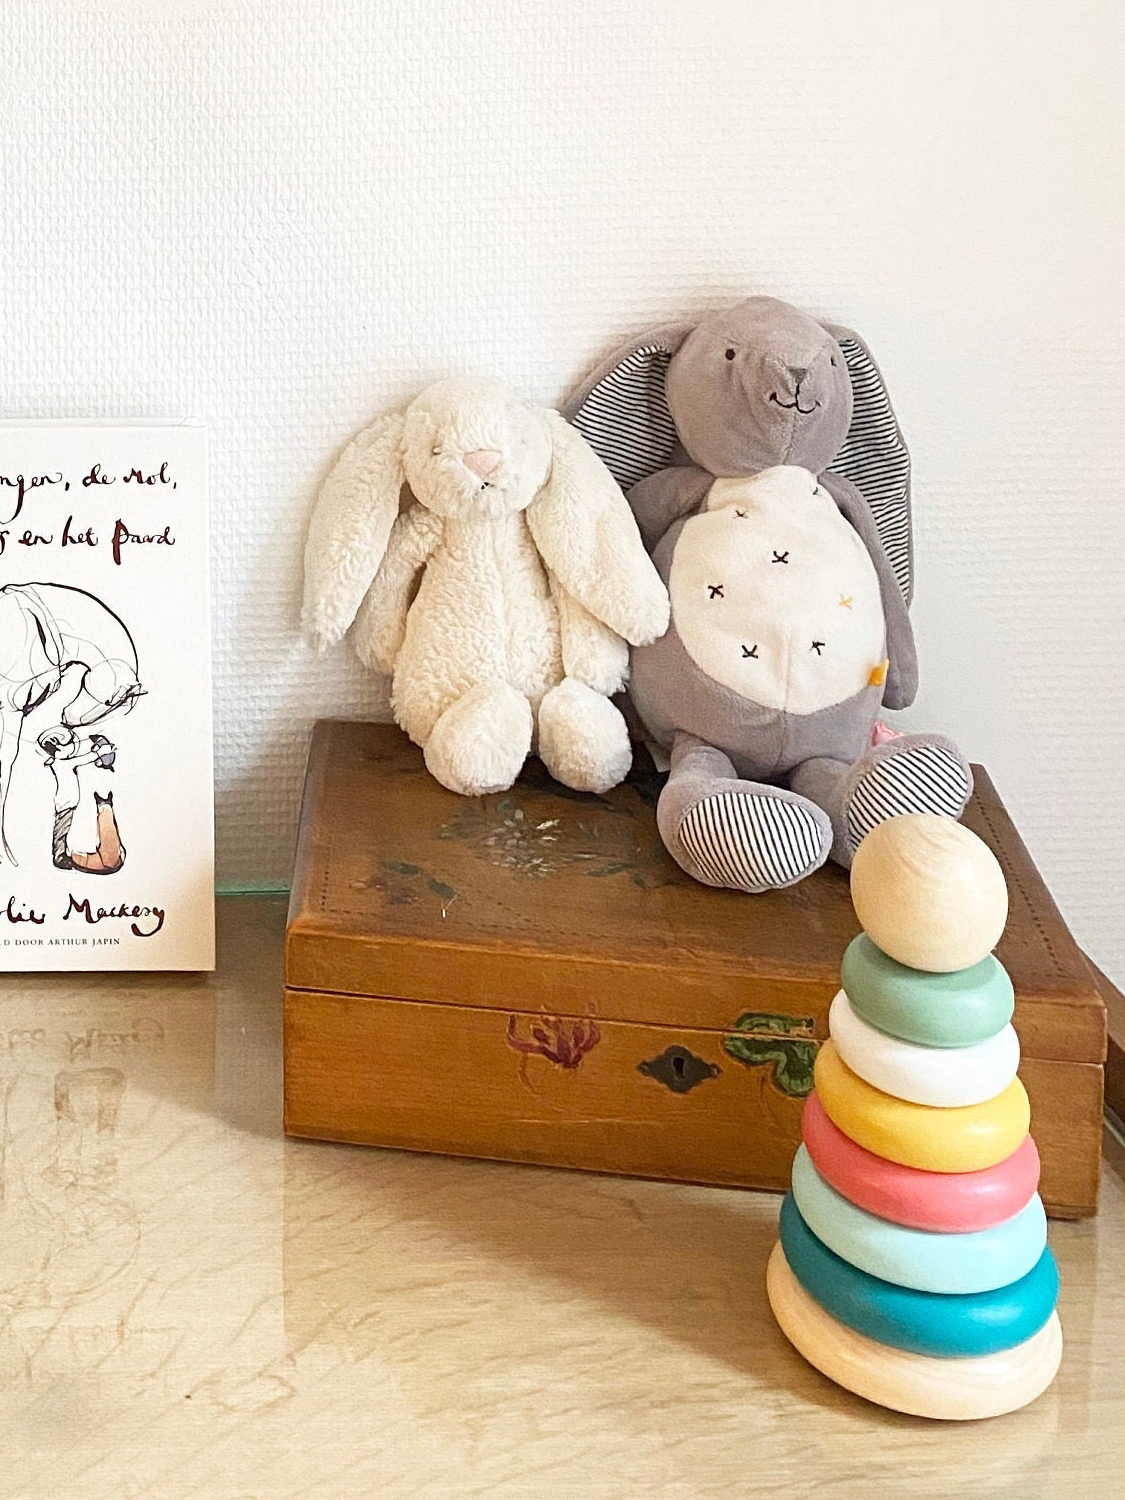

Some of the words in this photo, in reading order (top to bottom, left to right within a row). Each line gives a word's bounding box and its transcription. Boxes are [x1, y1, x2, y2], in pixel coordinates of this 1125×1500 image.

[82, 463, 116, 488] de
[123, 461, 177, 490] Mol,
[18, 530, 54, 547] en
[61, 515, 100, 548] het
[14, 938, 44, 947] DOOR
[47, 938, 88, 947] ARTHUR
[91, 937, 121, 948] JAPIN
